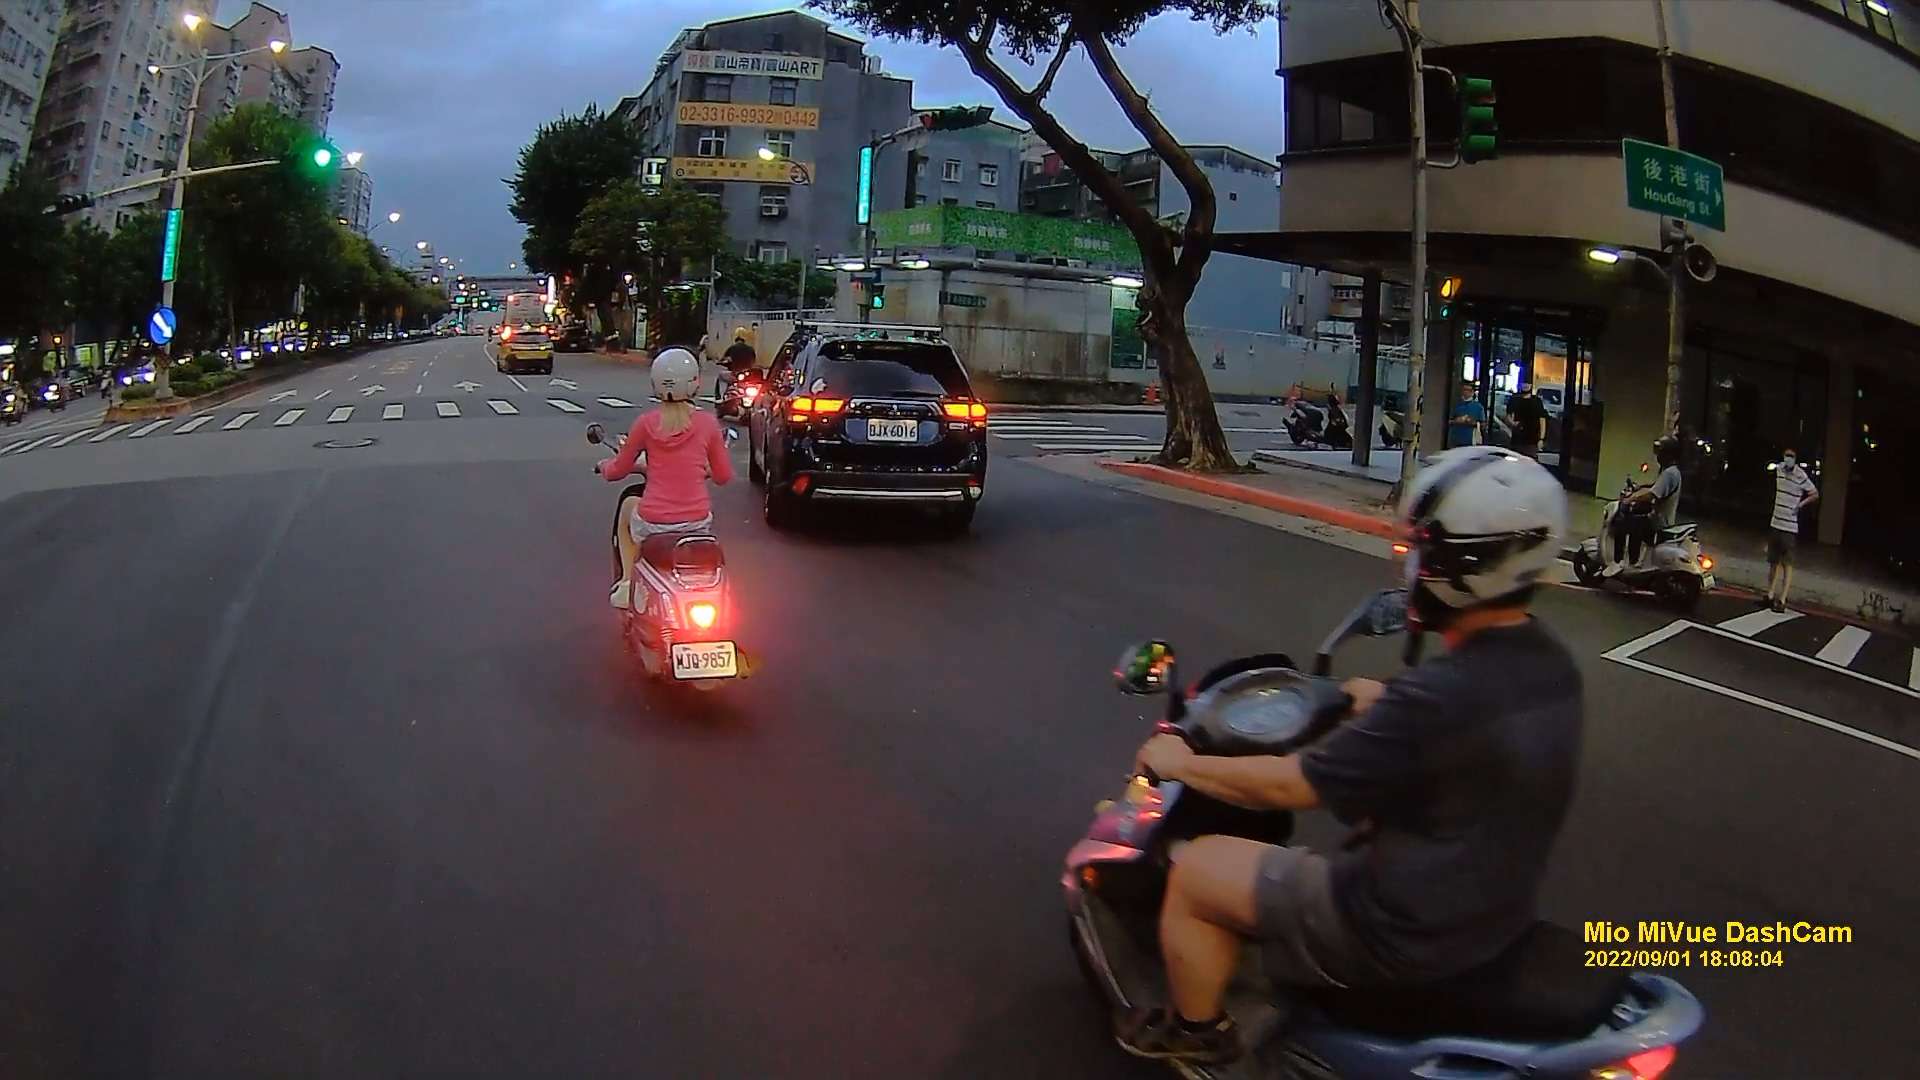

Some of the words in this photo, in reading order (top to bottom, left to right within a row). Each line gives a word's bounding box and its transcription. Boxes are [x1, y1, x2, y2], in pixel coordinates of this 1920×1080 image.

[1642, 157, 1710, 195] 後港街
[1643, 186, 1696, 214] HouGang
